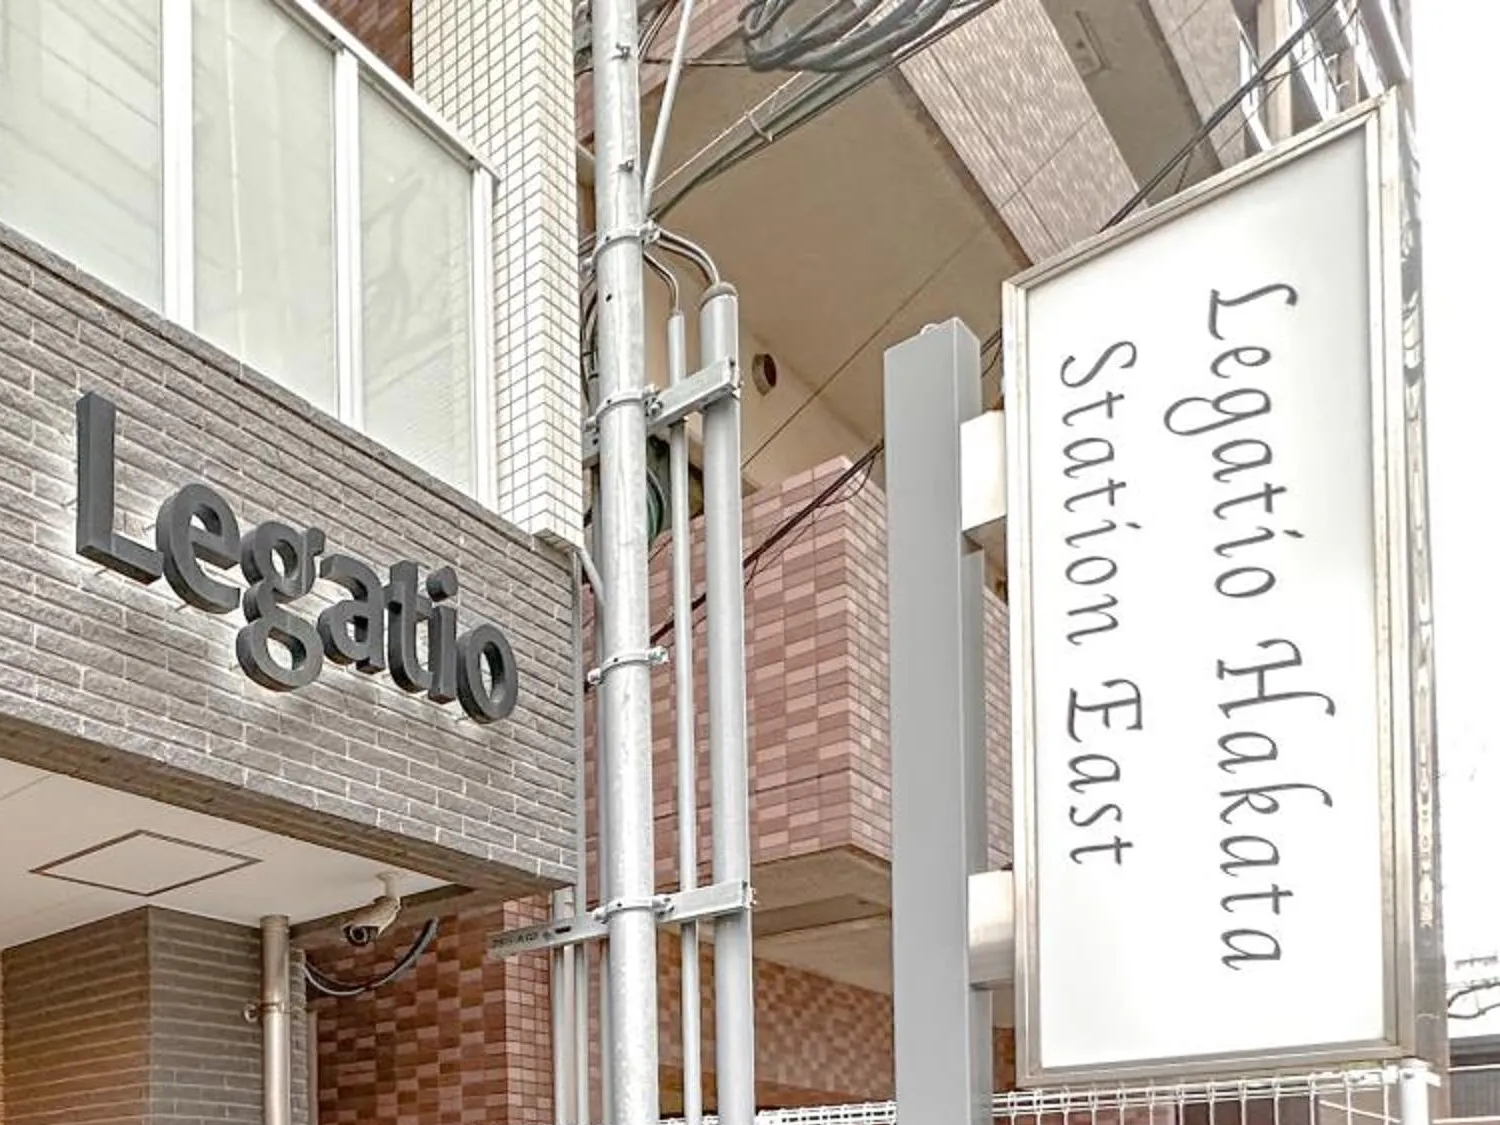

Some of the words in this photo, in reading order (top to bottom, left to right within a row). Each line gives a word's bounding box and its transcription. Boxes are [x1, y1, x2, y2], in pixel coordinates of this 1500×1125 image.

[75, 391, 519, 725] Legatio
[1059, 340, 1142, 646] Station
[1163, 282, 1304, 599] Legatio
[1067, 678, 1144, 866] East
[1216, 638, 1336, 971] Hakata
